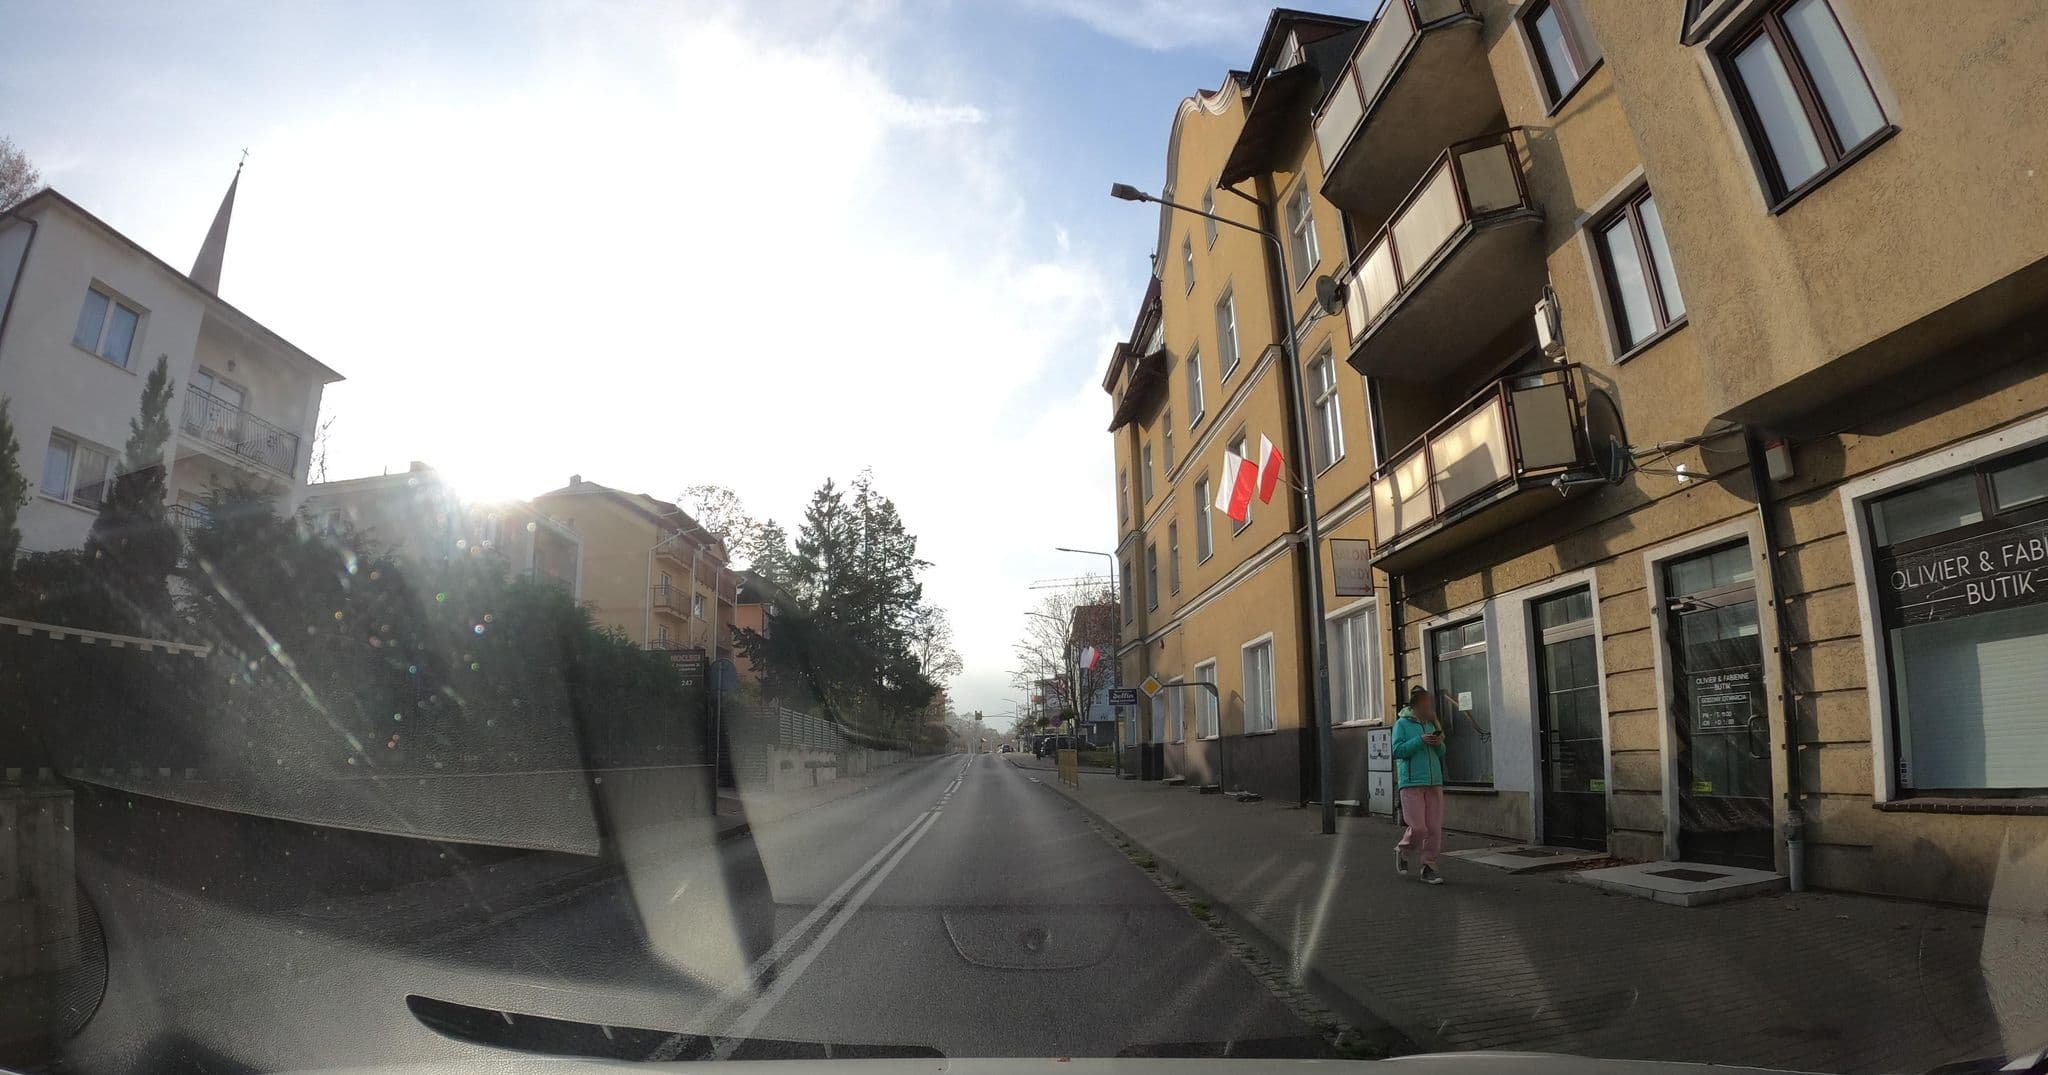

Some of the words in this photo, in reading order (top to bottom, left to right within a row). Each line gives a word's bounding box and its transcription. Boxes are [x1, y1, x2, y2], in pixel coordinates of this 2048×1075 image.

[1891, 555, 1971, 591] OLIVIER
[1979, 550, 1995, 572] &
[1966, 571, 2036, 605] BUTIK
[1696, 676, 1717, 685] OLIVIER
[1723, 672, 1749, 681] FABIENNE
